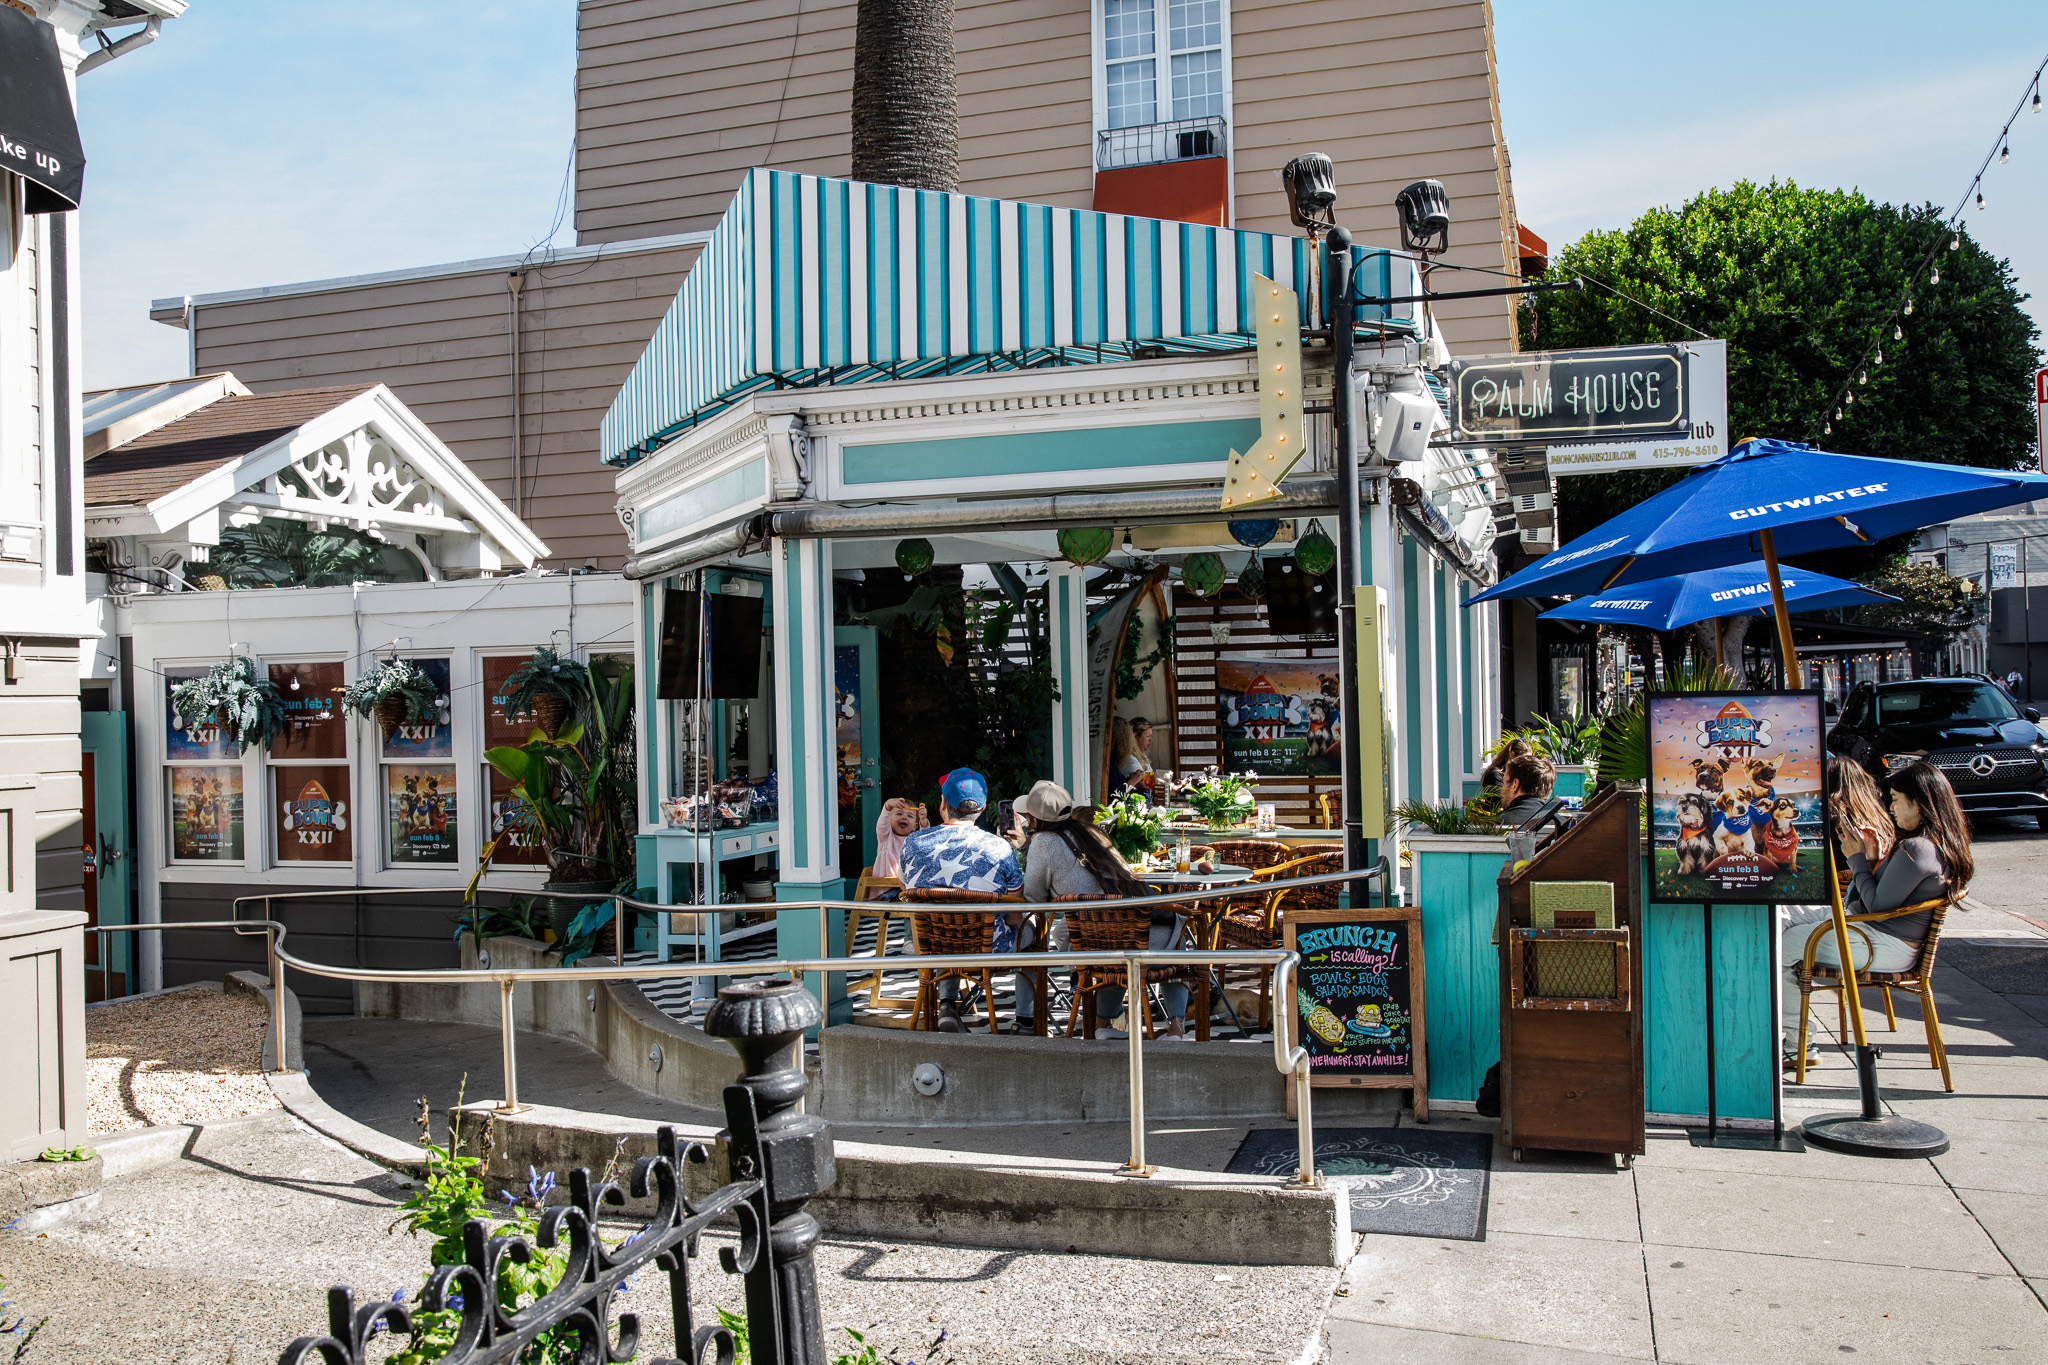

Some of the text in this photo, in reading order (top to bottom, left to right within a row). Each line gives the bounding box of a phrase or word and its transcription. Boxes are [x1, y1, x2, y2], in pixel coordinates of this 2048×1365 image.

[0, 134, 61, 176] ke up
[1471, 371, 1661, 419] PALM HOUSE
[1690, 420, 1715, 440] lub
[1652, 444, 1719, 460] 415-796-3610
[1728, 482, 1888, 520] CUTWATER
[1711, 579, 1797, 602] CUTWATR
[1589, 600, 1653, 611] CUTWATER
[304, 697, 323, 710] feb
[1235, 692, 1293, 711] PUPPY
[1238, 705, 1291, 724] BOWL
[398, 725, 436, 739] XXII
[1705, 717, 1763, 732] PUPPY
[186, 729, 220, 742] XXII
[1243, 725, 1286, 740] XXII
[1708, 728, 1761, 744] BOWL
[1249, 748, 1262, 757] feb
[1263, 748, 1269, 757] 8
[1714, 746, 1756, 759] XXII
[290, 799, 339, 815] PUPPY
[293, 811, 336, 829] BOWL
[297, 830, 333, 844] XXII
[1736, 865, 1752, 873] feb
[1752, 865, 1760, 873] 8
[1297, 925, 1397, 955] BRUNCH
[1310, 971, 1389, 985] BOWLS EGGS
[1315, 984, 1389, 998] SALADS SANDOS
